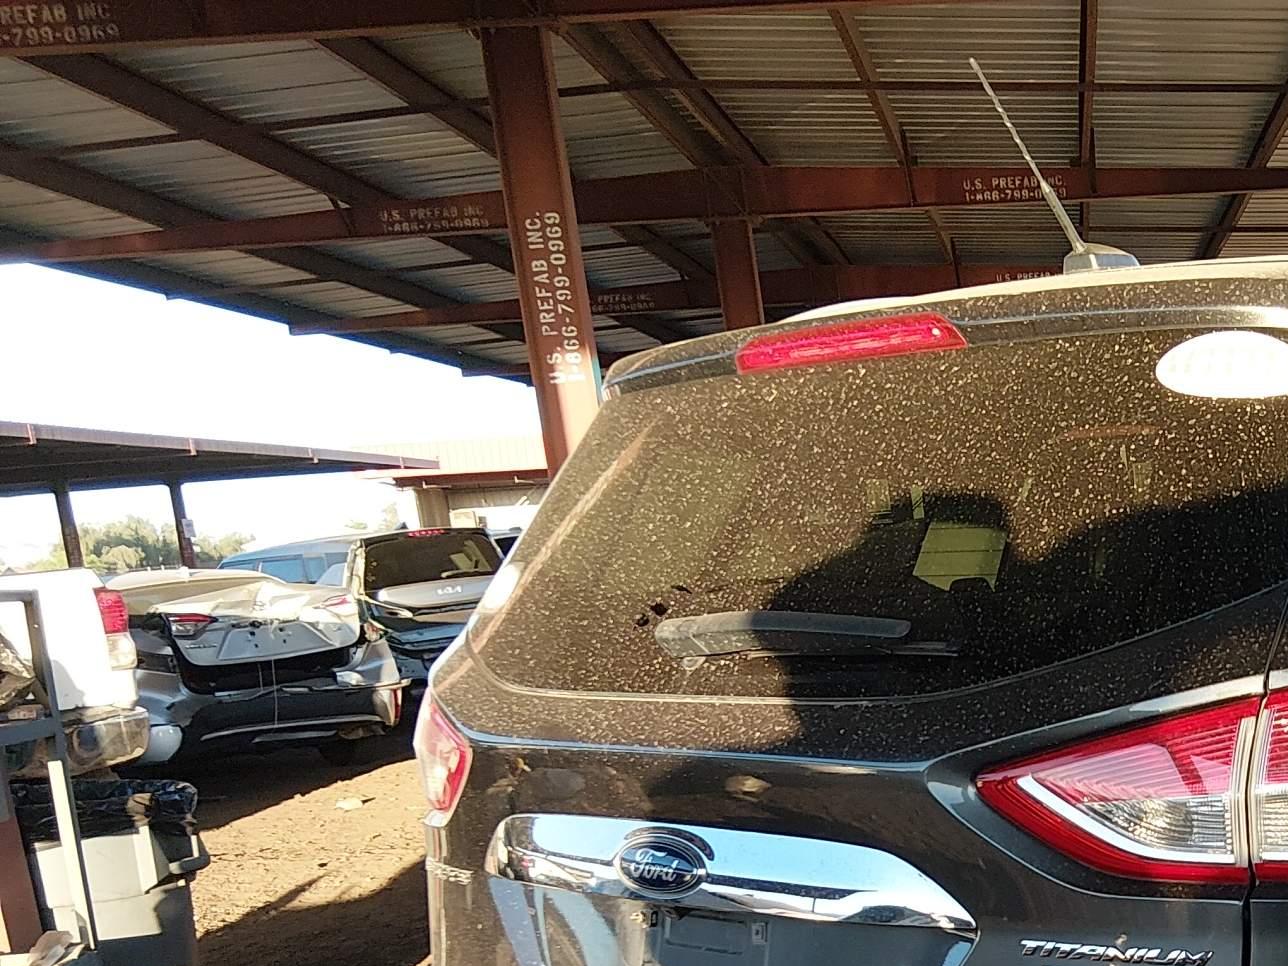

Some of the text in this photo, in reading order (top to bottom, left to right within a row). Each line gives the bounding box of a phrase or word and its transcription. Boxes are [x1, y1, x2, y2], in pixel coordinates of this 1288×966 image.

[963, 177, 987, 191] U.S.
[991, 175, 1038, 189] PREFAB
[525, 211, 545, 250] INC.
[531, 259, 559, 336] PREFAB
[543, 211, 587, 383] 1-866-799-0969
[629, 847, 682, 881] Ford
[1020, 939, 1214, 966] TITANIUM
